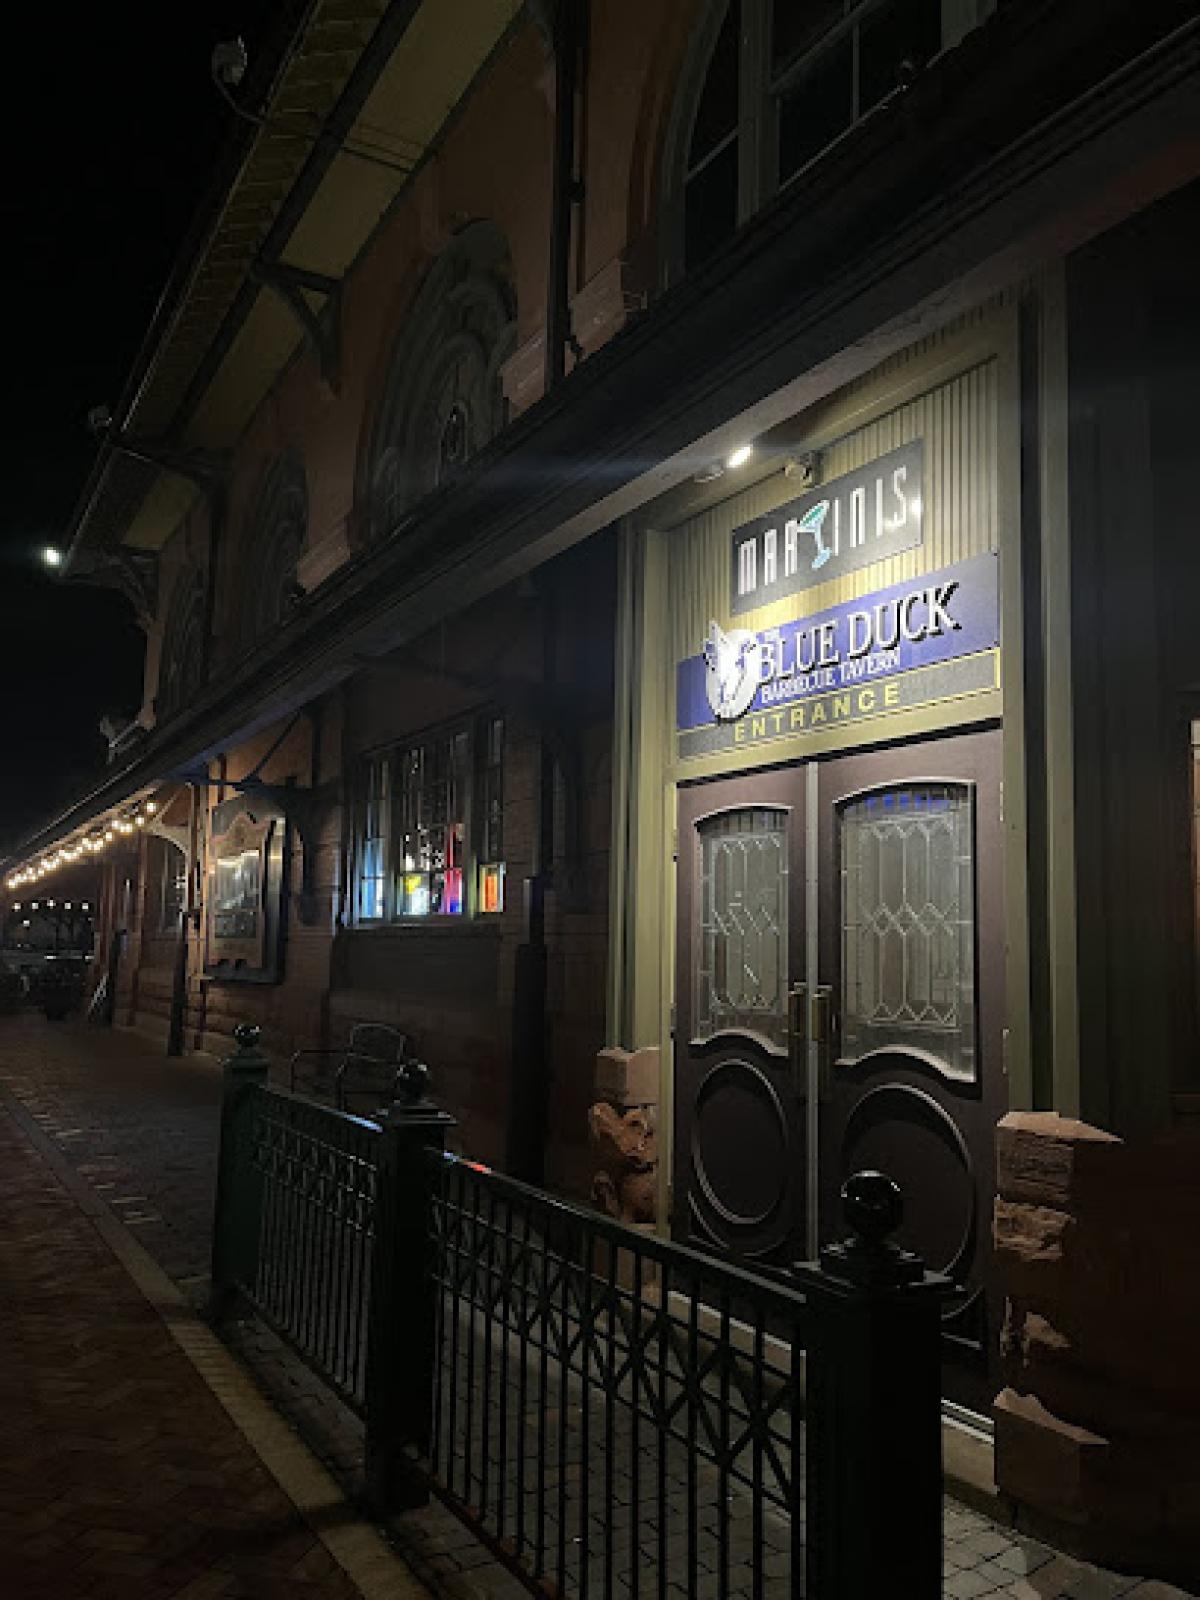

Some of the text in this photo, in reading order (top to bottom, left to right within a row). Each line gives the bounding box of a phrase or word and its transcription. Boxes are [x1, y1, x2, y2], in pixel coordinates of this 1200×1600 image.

[754, 579, 962, 685] BLUE DUCK
[733, 682, 901, 742] ENTRANCE
